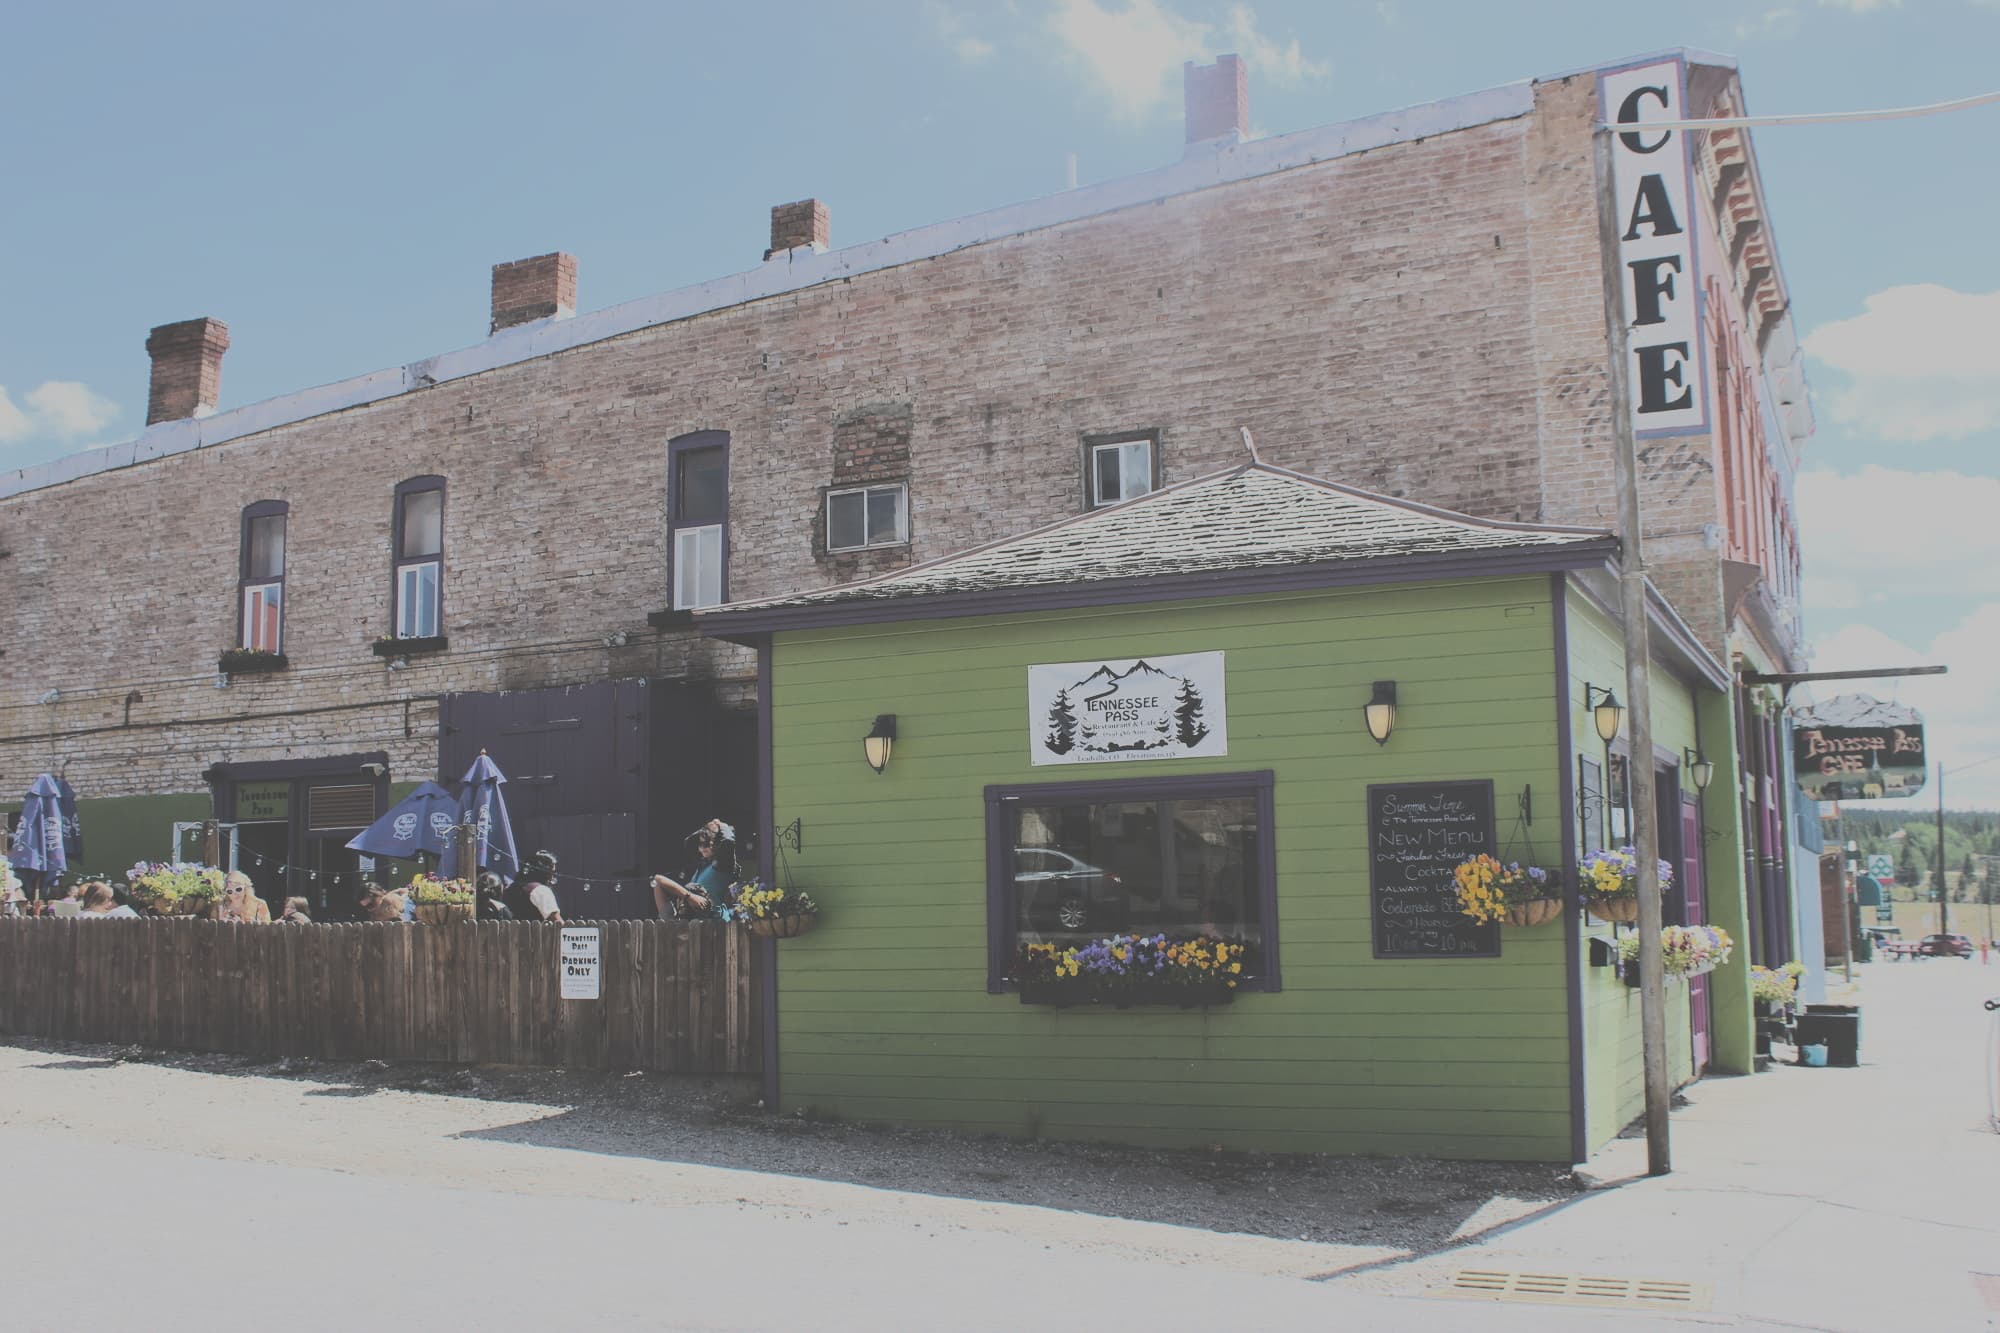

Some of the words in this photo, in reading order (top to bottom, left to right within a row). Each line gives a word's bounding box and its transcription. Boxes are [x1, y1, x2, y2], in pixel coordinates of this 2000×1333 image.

[1617, 86, 1693, 414] CAFE
[1084, 697, 1159, 712] TENNESSEE
[1105, 710, 1139, 722] PASS
[1379, 829, 1422, 847] NEW
[562, 956, 598, 965] PARKING
[568, 966, 591, 976] ONLY
